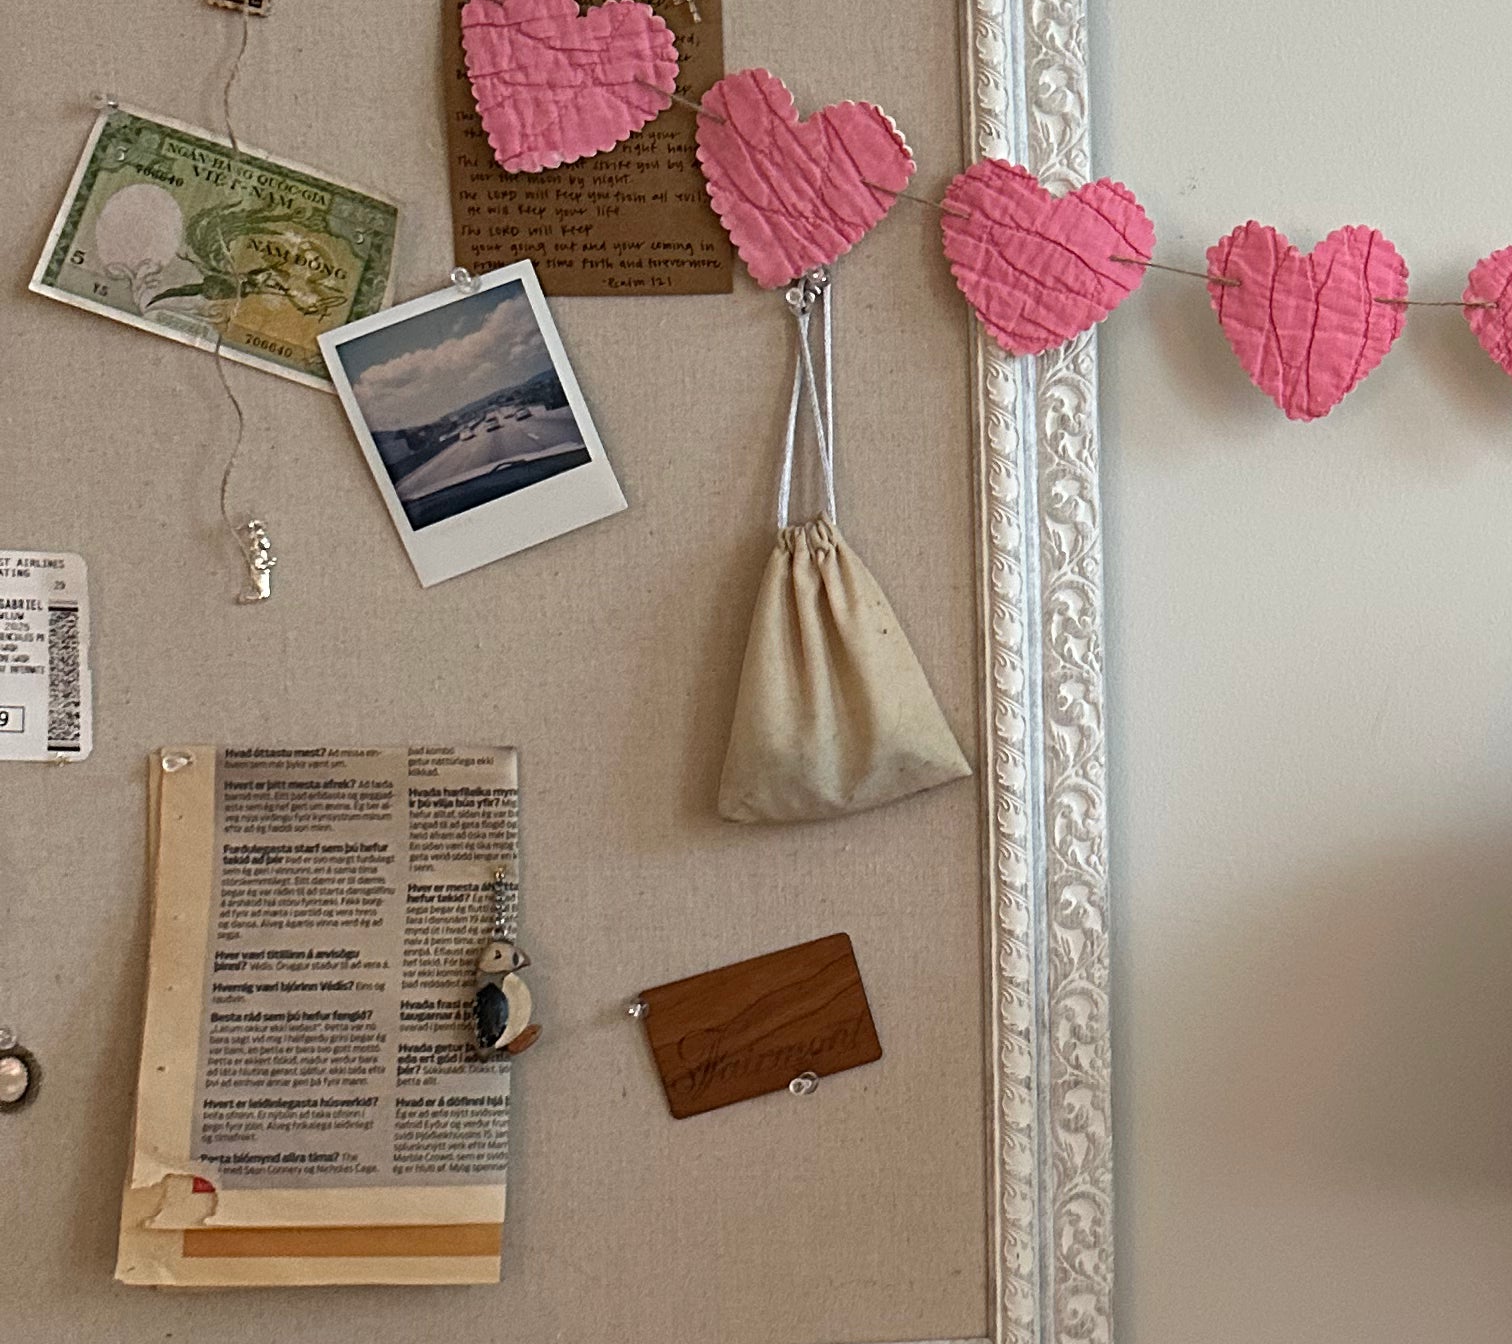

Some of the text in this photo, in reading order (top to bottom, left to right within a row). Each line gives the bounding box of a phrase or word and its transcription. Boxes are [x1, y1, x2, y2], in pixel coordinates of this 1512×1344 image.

[621, 143, 699, 156] right han
[636, 160, 660, 173] you
[667, 159, 684, 172] by
[569, 175, 584, 188] by
[487, 190, 518, 201] LORD
[525, 189, 550, 200] will
[651, 190, 669, 203] all
[555, 208, 588, 222] your
[489, 225, 520, 236] LORD
[528, 225, 553, 236] will
[471, 239, 715, 256] your going out and your coming in
[71, 249, 87, 265] 5
[582, 258, 613, 269] forth
[619, 258, 643, 268] and
[650, 276, 672, 287] 121
[17, 558, 65, 569] AIRLINES
